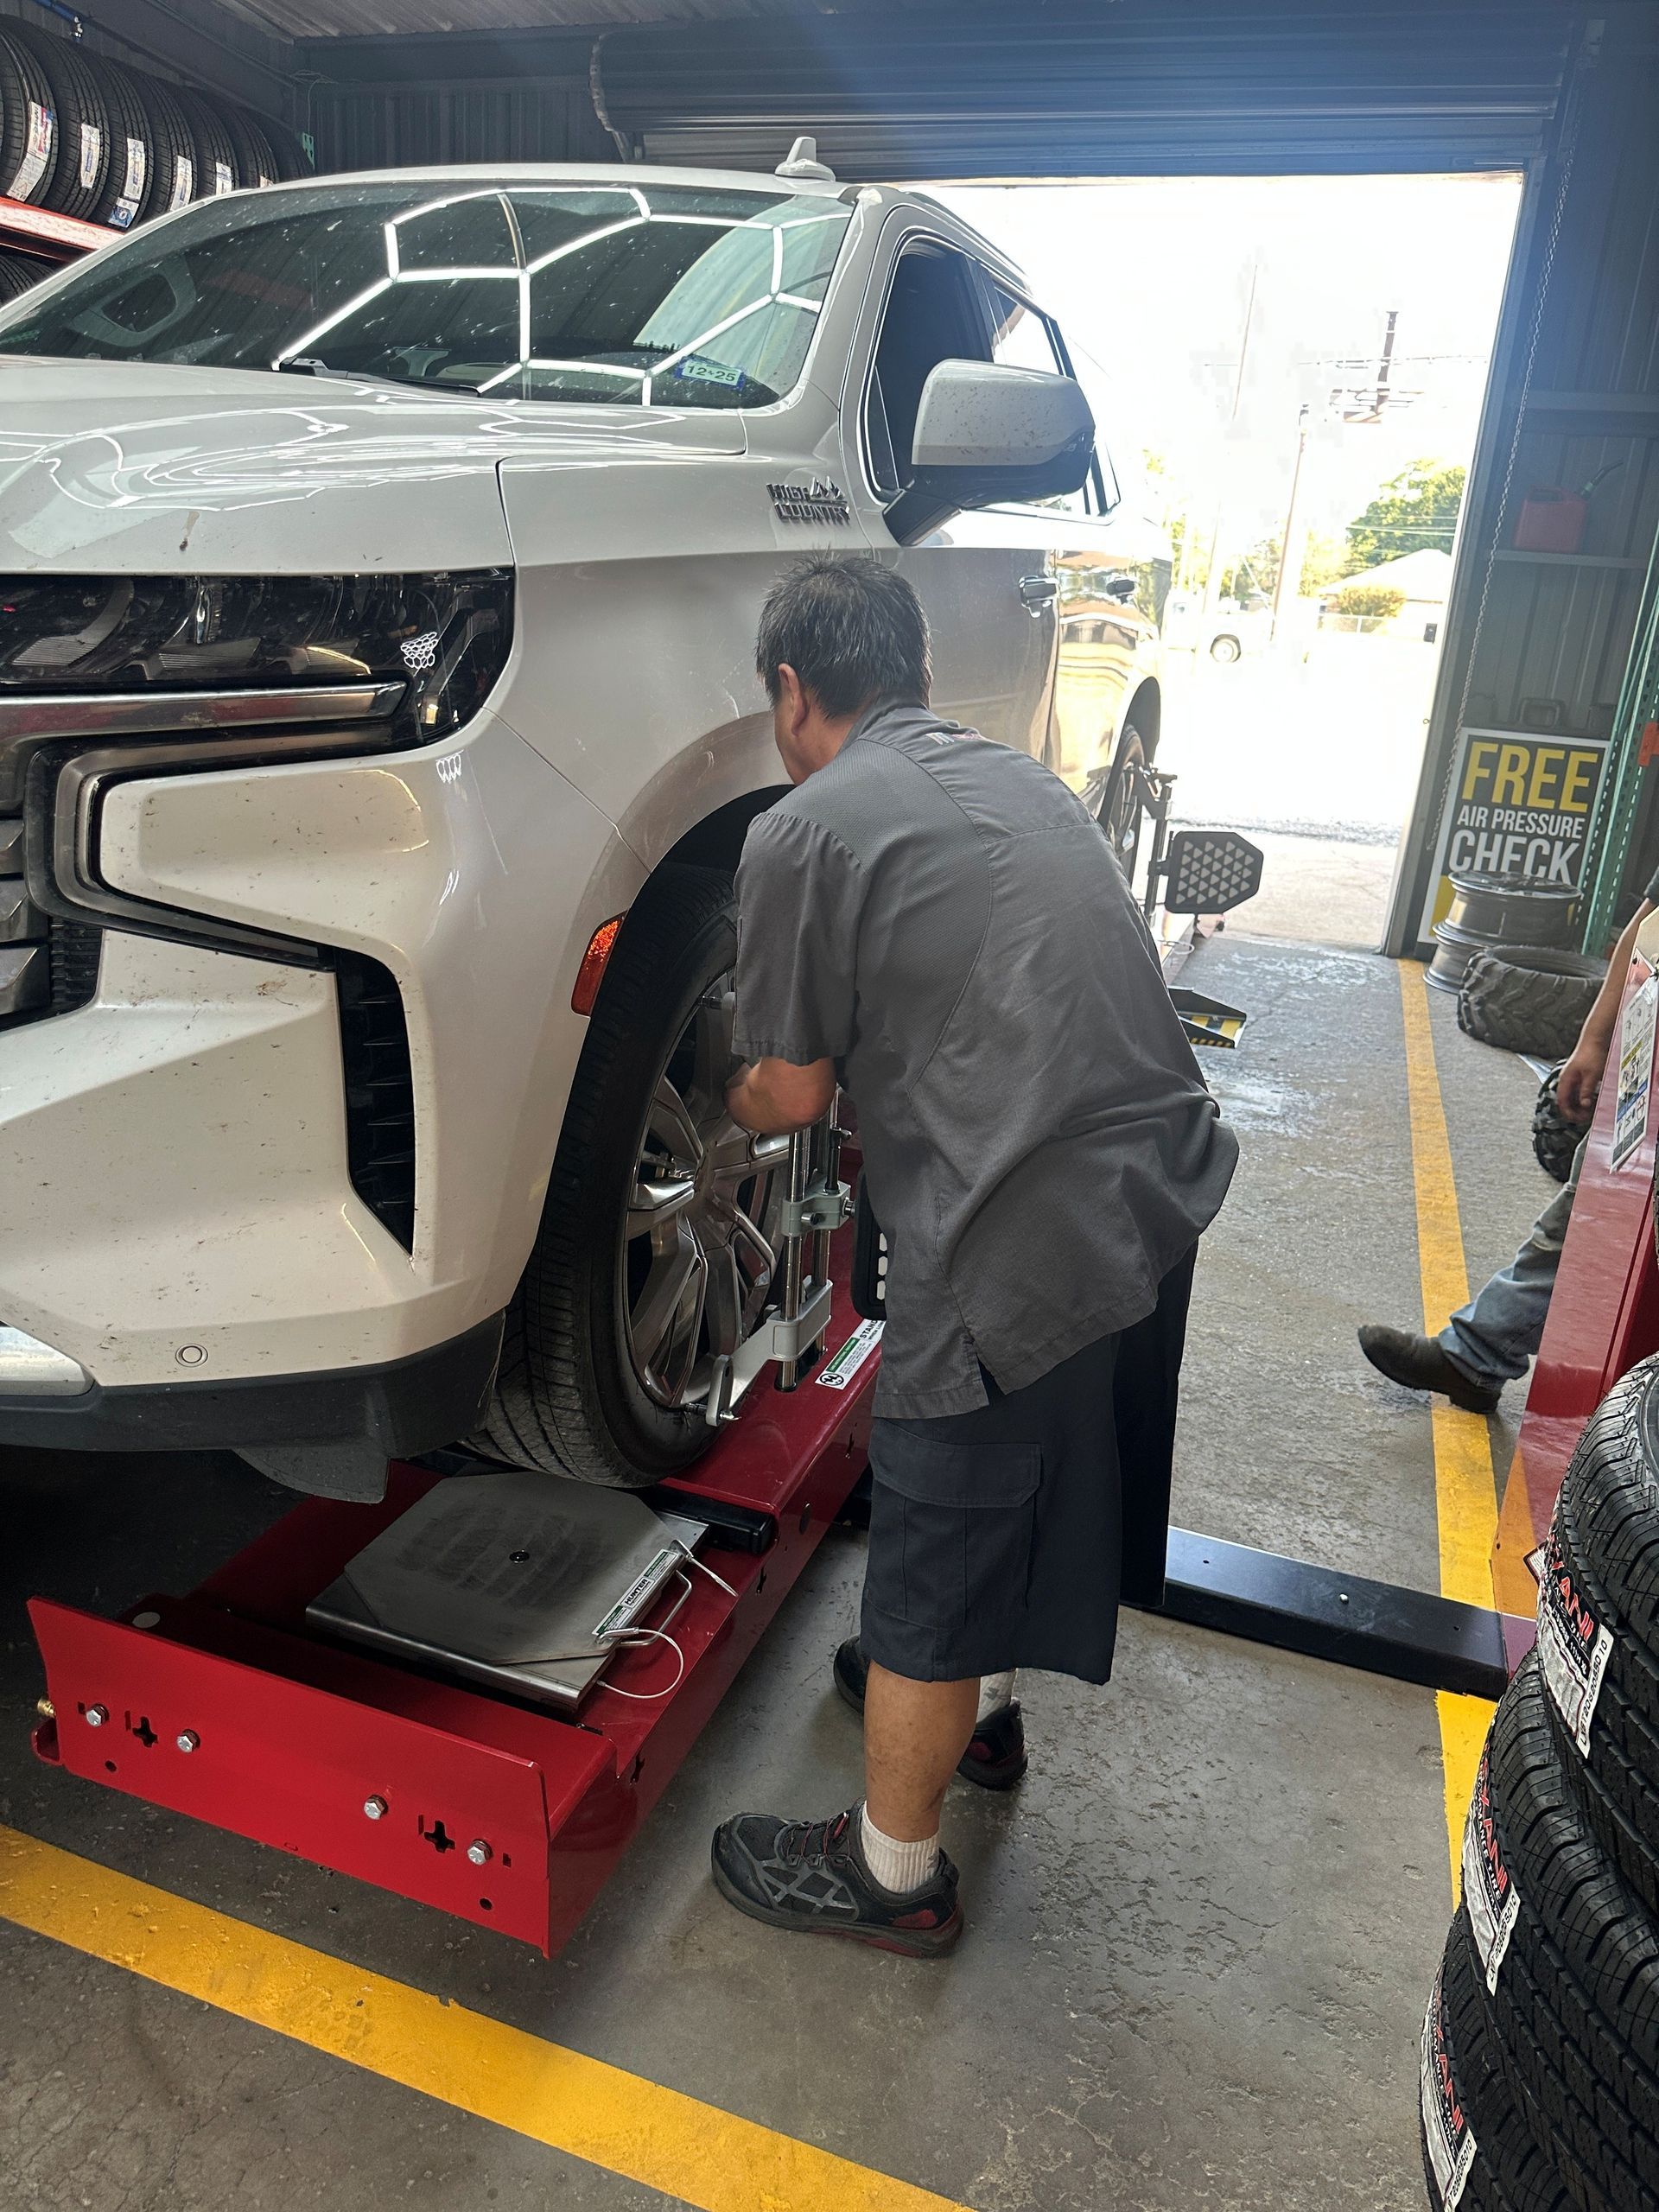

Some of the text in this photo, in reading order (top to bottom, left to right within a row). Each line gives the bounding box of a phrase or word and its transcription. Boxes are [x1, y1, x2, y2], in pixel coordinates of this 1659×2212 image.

[774, 502, 850, 523] COUNTRY
[1462, 741, 1599, 812] FREE
[1457, 805, 1585, 839] AIR PRESSURE
[1449, 830, 1580, 885] CHECK
[624, 1578, 648, 1605] HUNTER
[1488, 1864, 1503, 1901] TIRE
